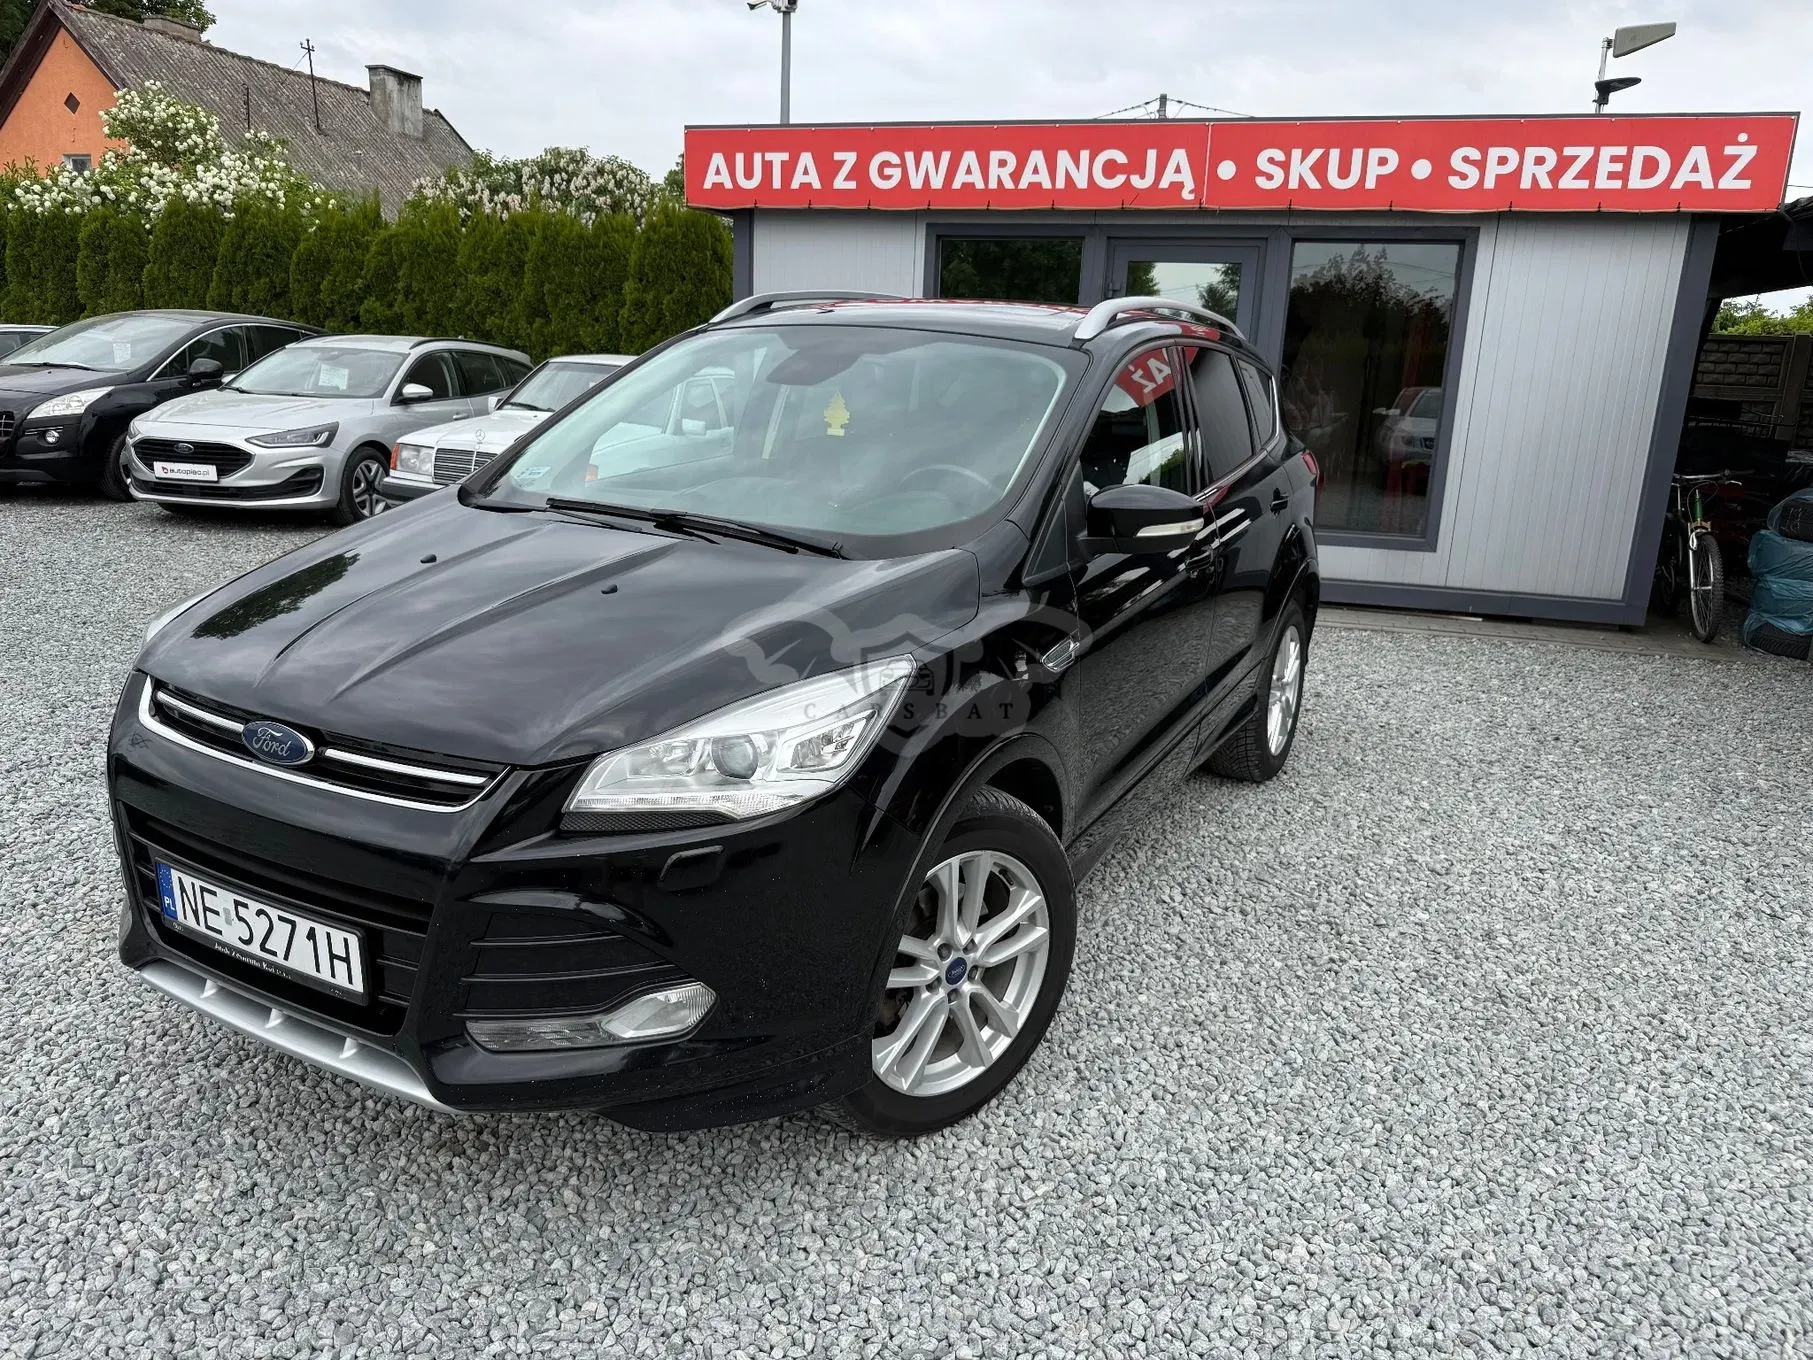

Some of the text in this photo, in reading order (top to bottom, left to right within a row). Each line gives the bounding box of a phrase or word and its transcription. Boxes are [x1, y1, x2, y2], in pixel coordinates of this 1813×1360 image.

[703, 148, 1196, 200] AUTA Z GWARANCJĄ
[1254, 132, 1759, 190] SKUP SPRZEDAŻ
[252, 727, 292, 757] Ford
[164, 897, 176, 911] PL
[178, 876, 223, 936] NE
[233, 899, 354, 985] 5271H
